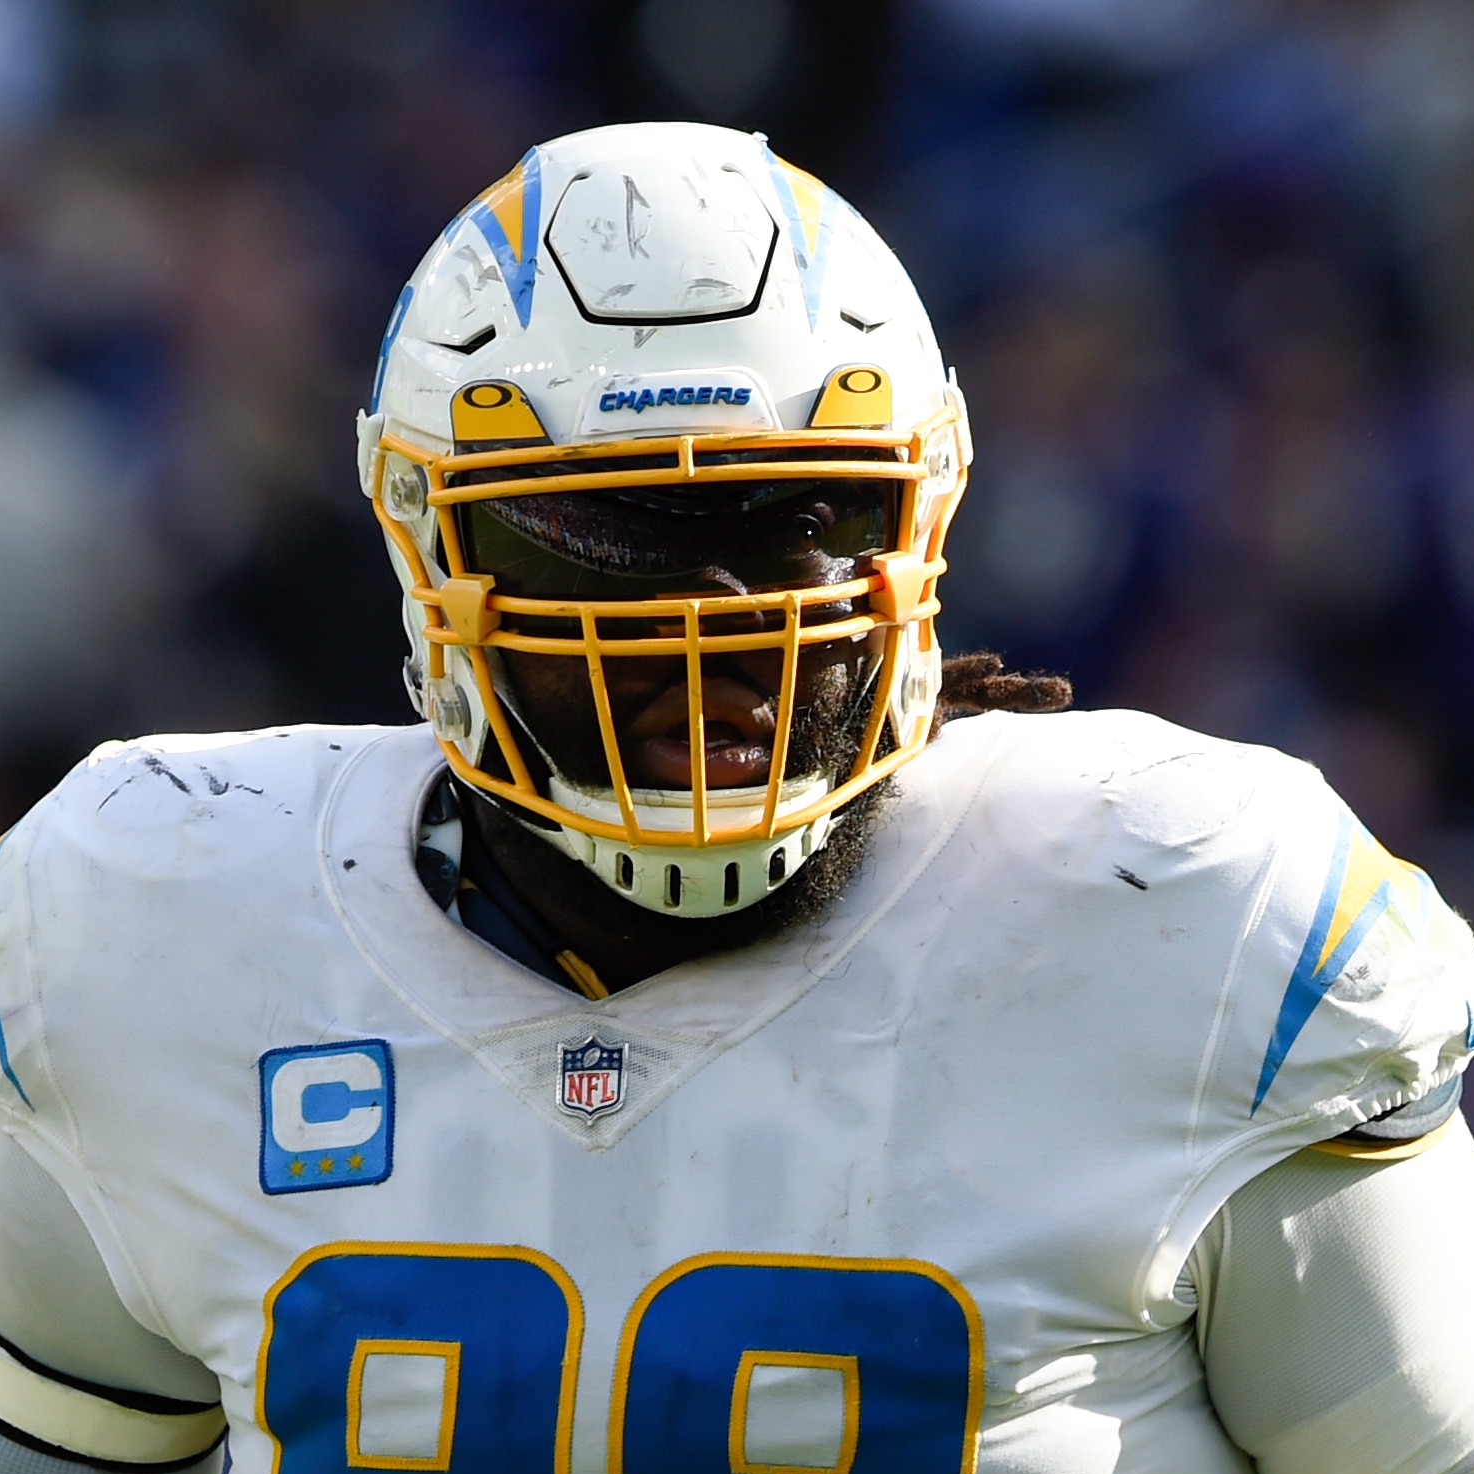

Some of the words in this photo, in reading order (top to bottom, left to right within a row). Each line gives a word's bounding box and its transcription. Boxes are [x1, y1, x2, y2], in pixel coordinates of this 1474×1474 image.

[599, 386, 752, 414] CHARGERS
[272, 1053, 382, 1152] C
[567, 1073, 615, 1108] NFL
